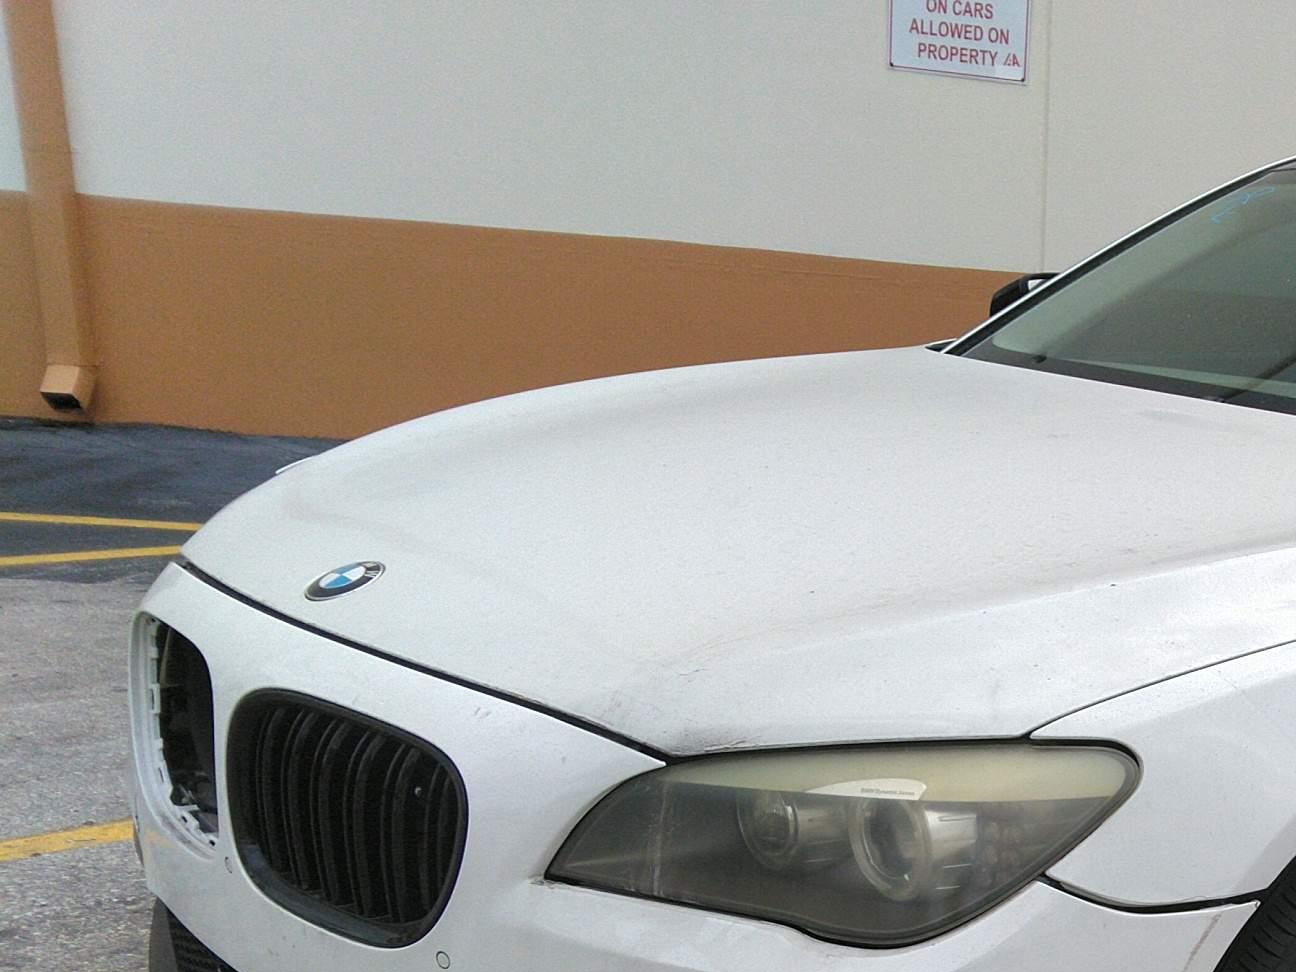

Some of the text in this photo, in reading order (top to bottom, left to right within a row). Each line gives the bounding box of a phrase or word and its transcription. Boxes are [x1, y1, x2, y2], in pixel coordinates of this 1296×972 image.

[926, 0, 994, 19] ON CARS
[909, 18, 1010, 45] ALLOWED ON
[918, 42, 998, 66] PROPERTY
